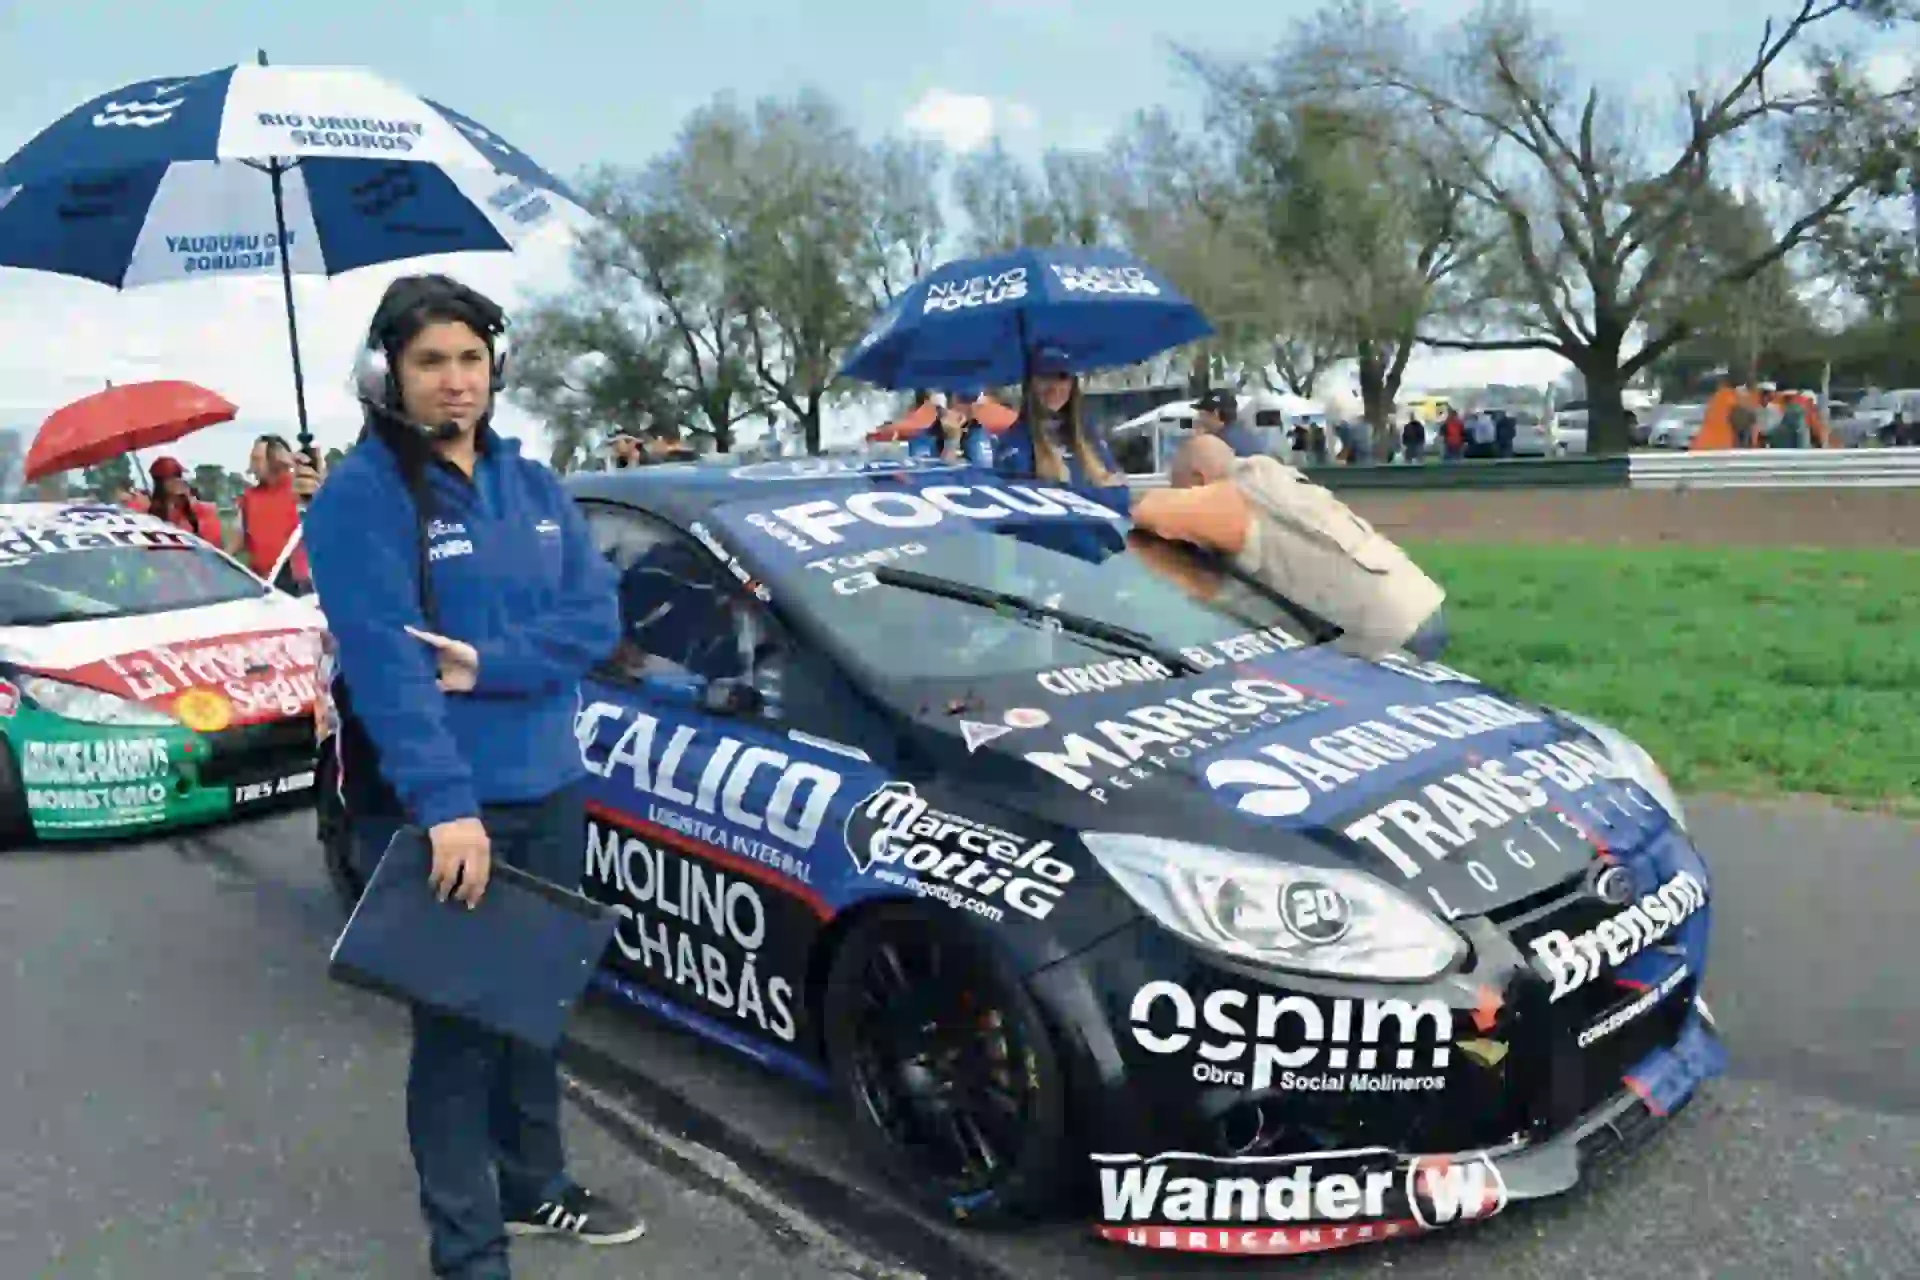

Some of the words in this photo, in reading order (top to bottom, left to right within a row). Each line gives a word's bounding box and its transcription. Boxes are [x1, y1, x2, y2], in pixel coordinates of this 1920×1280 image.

[257, 112, 302, 127] RIO
[291, 129, 414, 152] SEGUROS
[922, 281, 1029, 315] FOCUS
[928, 267, 1027, 297] NUEVO
[772, 485, 1123, 546] FOCUS
[1024, 679, 1304, 791] MARIGO
[574, 702, 842, 850] CALICO
[865, 789, 1076, 884] Marcelo
[585, 821, 766, 951] MOLINO
[1291, 888, 1342, 928] 20
[1529, 872, 1706, 1004] Brenson
[614, 903, 797, 1043] CHABÁS
[1192, 1062, 1246, 1087] Obra
[1280, 1070, 1345, 1092] Social
[1349, 1072, 1446, 1093] Molineros
[1099, 1164, 1393, 1223] Wander
